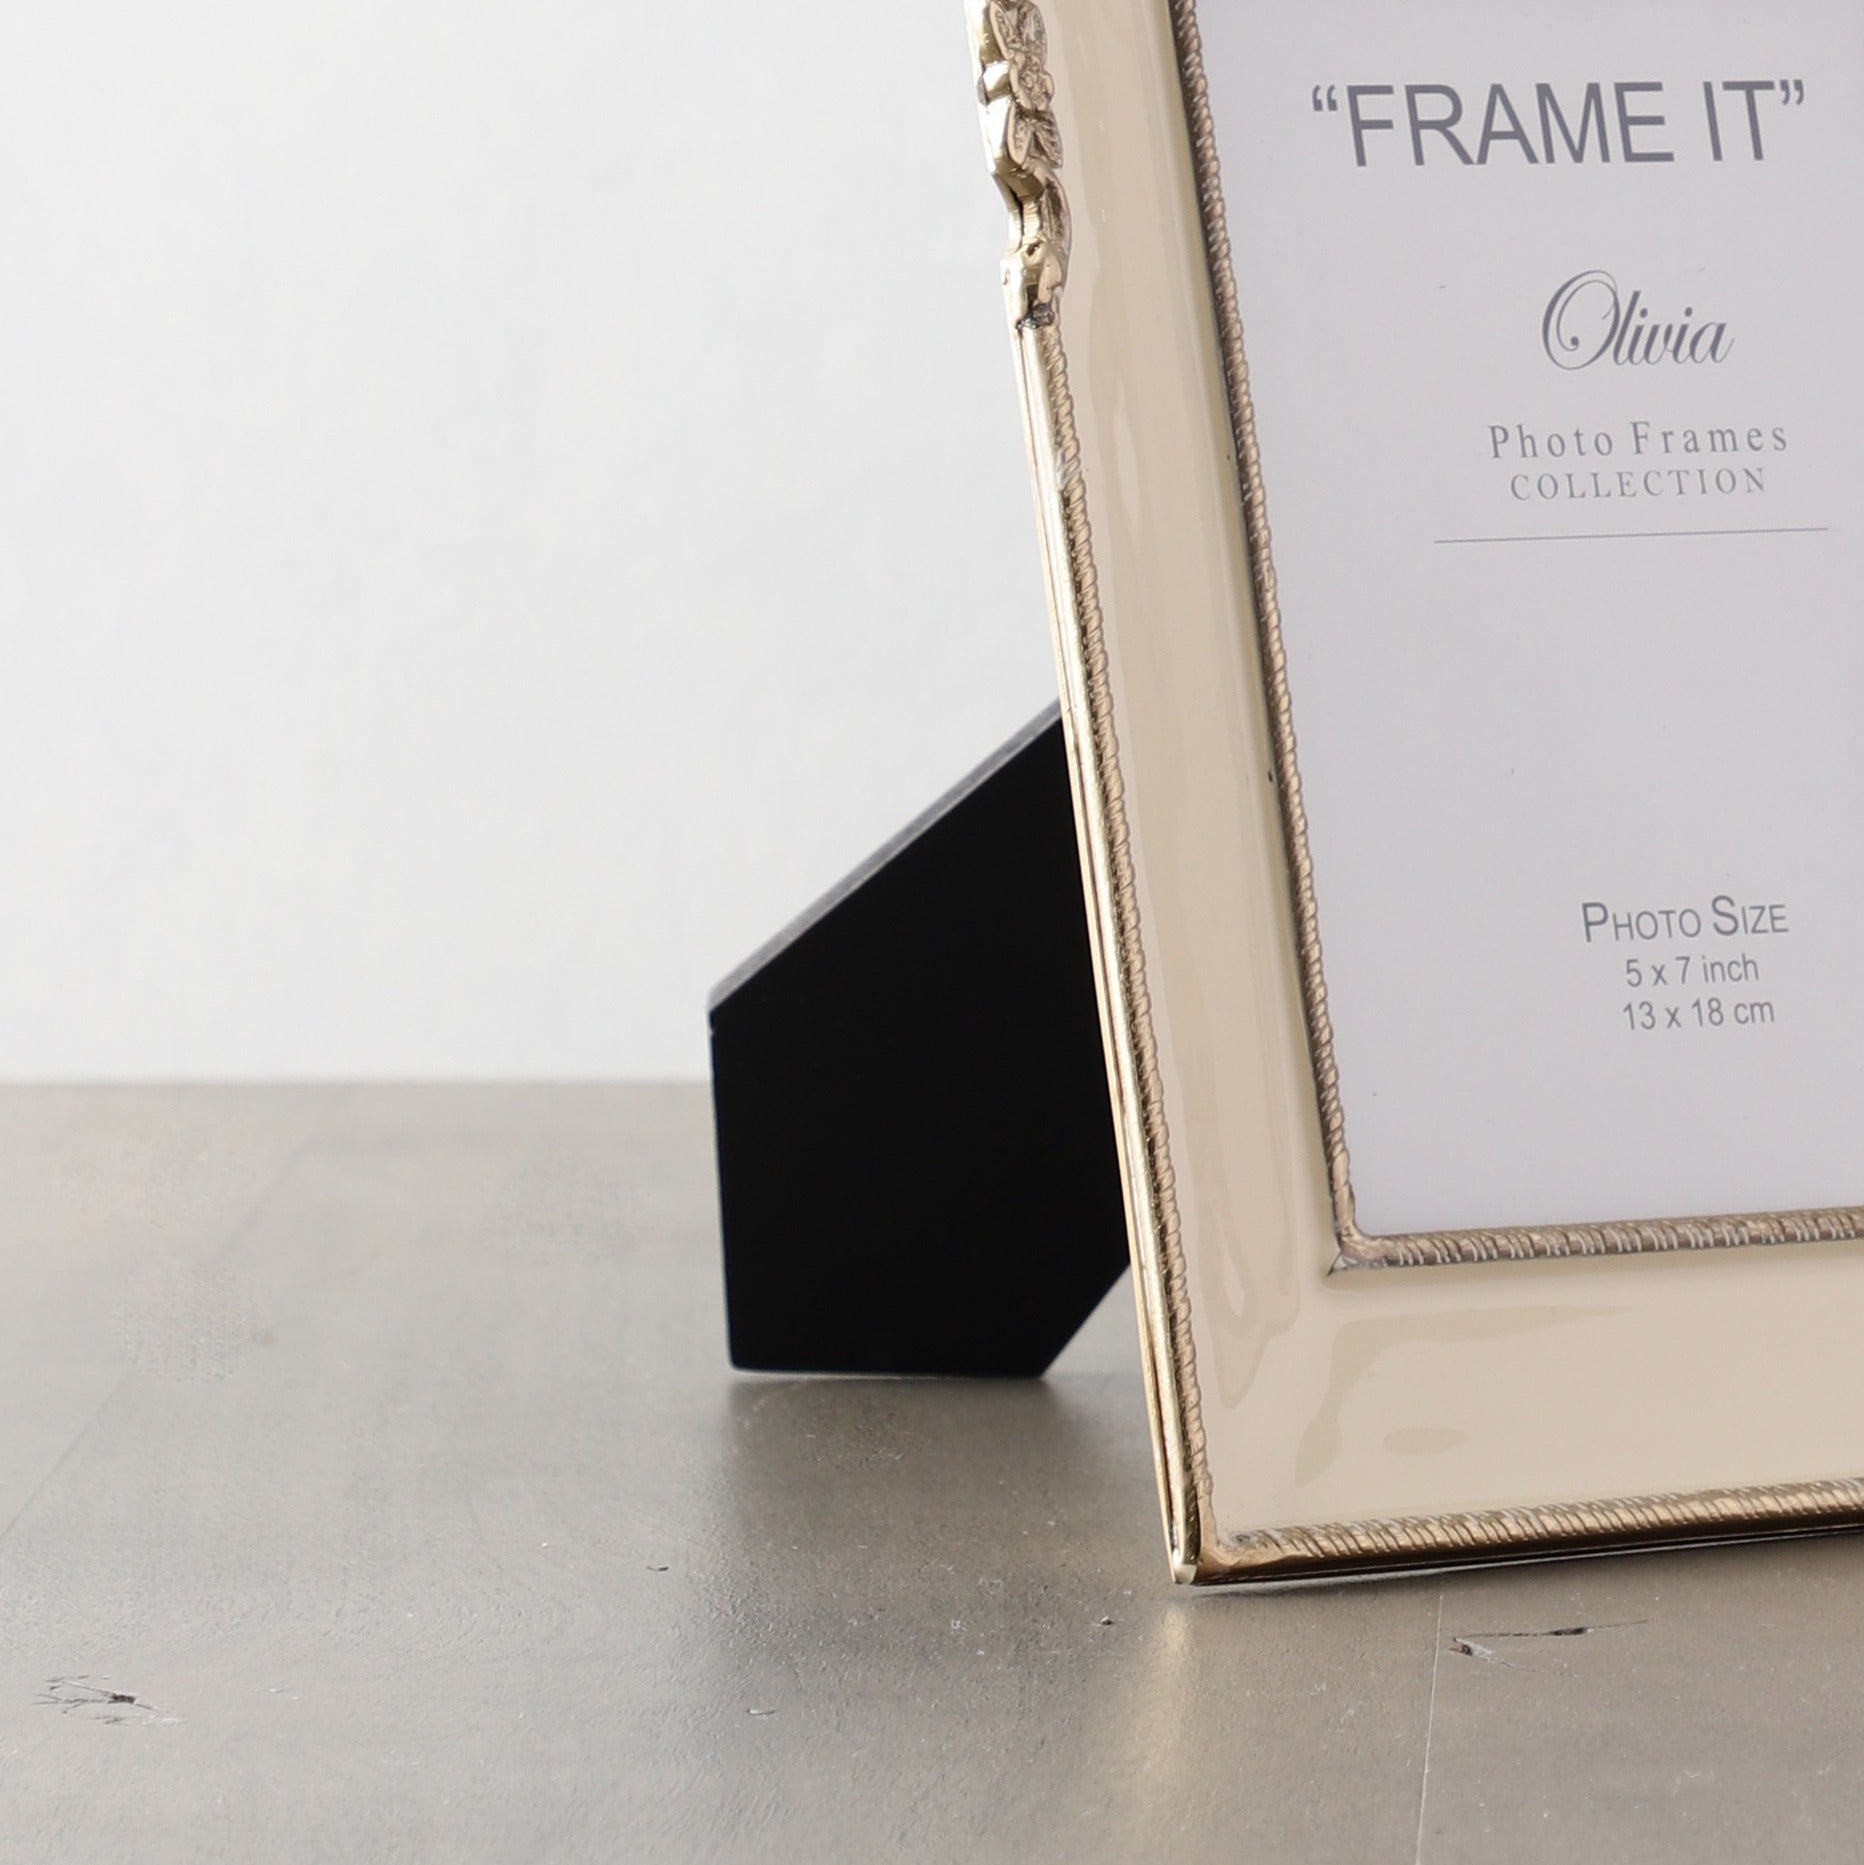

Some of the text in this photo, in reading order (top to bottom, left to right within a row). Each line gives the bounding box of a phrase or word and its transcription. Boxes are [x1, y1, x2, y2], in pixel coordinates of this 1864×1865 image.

[1541, 269, 1734, 371] Olivia
[1488, 420, 1788, 459] Photo Frames
[1510, 467, 1766, 501] COLLECTION
[1625, 952, 1760, 988] 5 x 7 inch
[1622, 996, 1776, 1031] 13 x 18 cm
